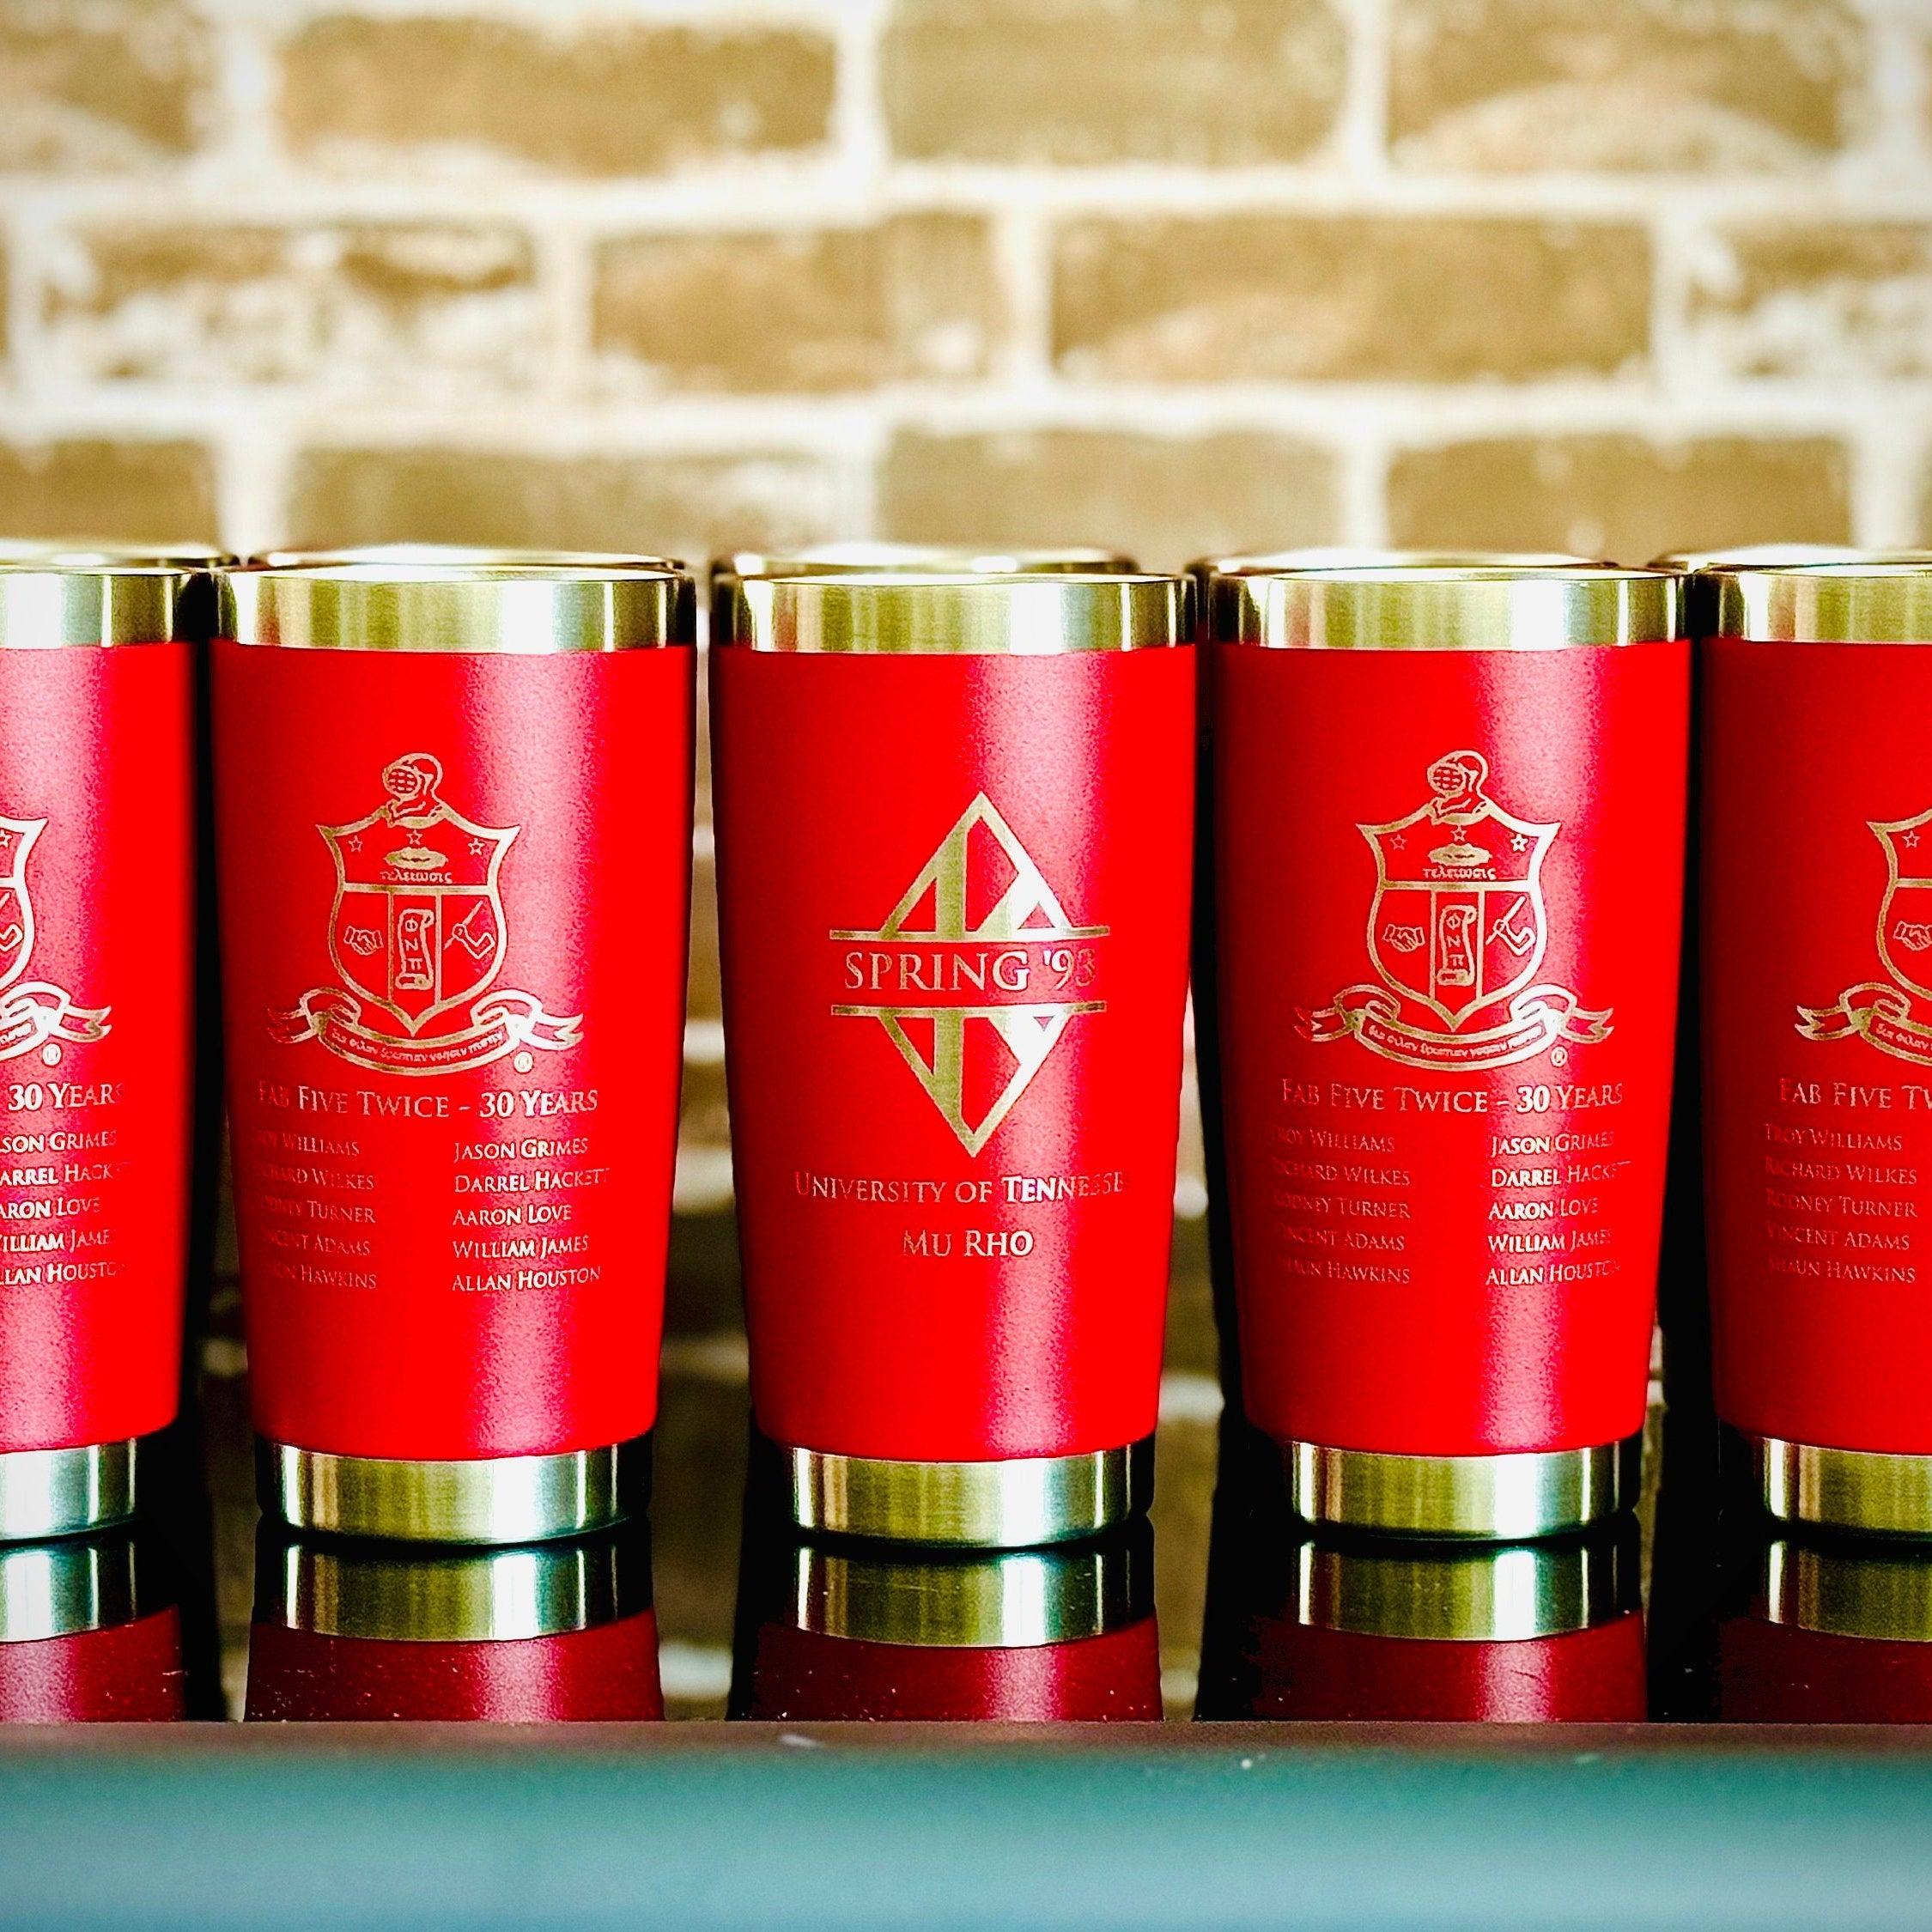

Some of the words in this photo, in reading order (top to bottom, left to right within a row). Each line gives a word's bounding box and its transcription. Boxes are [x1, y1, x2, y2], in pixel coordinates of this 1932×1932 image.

[845, 951, 1030, 992] SPRING
[1042, 949, 1096, 990] '93
[8, 1084, 43, 1111] 30
[299, 1085, 348, 1113] FIVE
[357, 1091, 449, 1117] TWICE
[479, 1091, 515, 1117] 30
[519, 1089, 598, 1116] YEARS
[1331, 1083, 1384, 1110] FIVE
[1393, 1086, 1488, 1113] TWICE
[1516, 1085, 1551, 1114] 30
[1555, 1083, 1623, 1110] YEARS
[1780, 1078, 1821, 1104] FAB
[1833, 1082, 1892, 1109] FIVE
[0, 1134, 45, 1153] SON
[454, 1142, 515, 1163] JASON
[521, 1138, 589, 1158] GRIMES
[1491, 1137, 1551, 1158] JASON
[1809, 1128, 1903, 1151] WILLIAMS
[0, 1167, 59, 1186] ARREL
[454, 1175, 530, 1194] DARREL
[1343, 1165, 1411, 1186] WILKES
[1492, 1169, 1561, 1188] DARREL
[1846, 1164, 1917, 1185] WILKES
[795, 1172, 945, 1203] UNIVERSITY
[955, 1181, 993, 1203] OF
[307, 1200, 376, 1224] TURNER
[453, 1207, 522, 1226] AARON
[527, 1204, 573, 1224] LOVE
[1336, 1197, 1411, 1219] TURNER
[1488, 1202, 1554, 1221] AARON
[1838, 1196, 1918, 1218] TURNER
[0, 1233, 65, 1253] ILLIAM
[70, 1228, 117, 1253] JAME
[453, 1240, 536, 1259] WILLIAM
[540, 1235, 589, 1260] JAMES
[903, 1230, 951, 1257] MU
[965, 1230, 1034, 1258] RHO
[1345, 1231, 1405, 1251] ADAMS
[1487, 1234, 1566, 1254] WILLIAM
[1844, 1231, 1910, 1251] ADAMS
[0, 1266, 42, 1285] LAN
[47, 1262, 126, 1284] HOUSTO
[453, 1274, 512, 1291] ALLAN
[518, 1267, 601, 1290] HOUSTON
[1327, 1261, 1411, 1285] HAWKINS
[1485, 1268, 1544, 1286] ALLAN
[1826, 1261, 1916, 1284] HAWKINS
